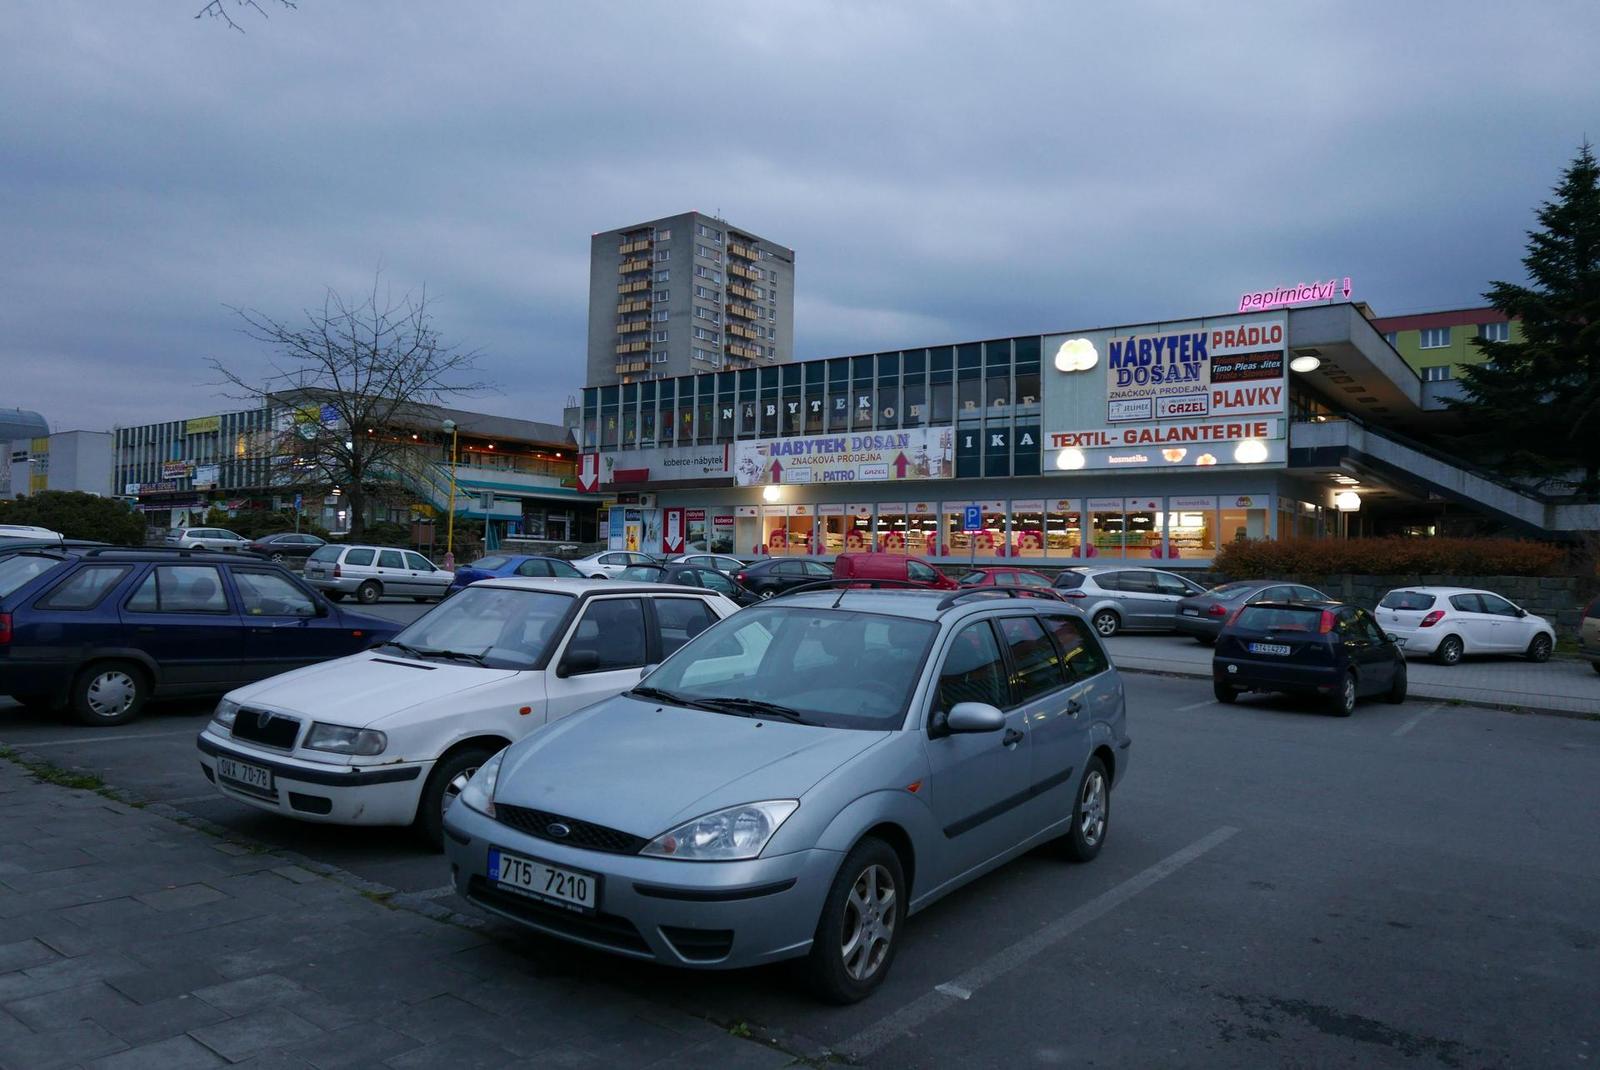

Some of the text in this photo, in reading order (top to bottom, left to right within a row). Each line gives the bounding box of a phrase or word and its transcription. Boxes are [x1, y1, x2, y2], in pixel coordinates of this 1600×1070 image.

[1239, 280, 1335, 311] papírnictví
[1212, 325, 1283, 349] PRÁDLO
[1109, 333, 1208, 369] NÁBYTEK
[1116, 361, 1202, 387] DOSAN
[1260, 360, 1281, 369] Jitex
[1110, 385, 1208, 399] ZNAČKOVÁ PRODEJNA
[1213, 386, 1282, 409] PLAVKY
[722, 396, 870, 419] NÁBYTEK
[1168, 402, 1206, 413] GAZEL
[1123, 422, 1268, 444] GALANTERIE
[770, 433, 909, 457] NÁBYTEK DOSAN
[792, 453, 882, 465] ZNAČKOVÁ PRODEJNA
[1109, 454, 1148, 464] kosmetika
[814, 472, 822, 482] 1.
[823, 469, 855, 482] PATRO
[968, 508, 978, 523] P
[502, 857, 532, 885] 7T5
[545, 869, 587, 901] 7210
